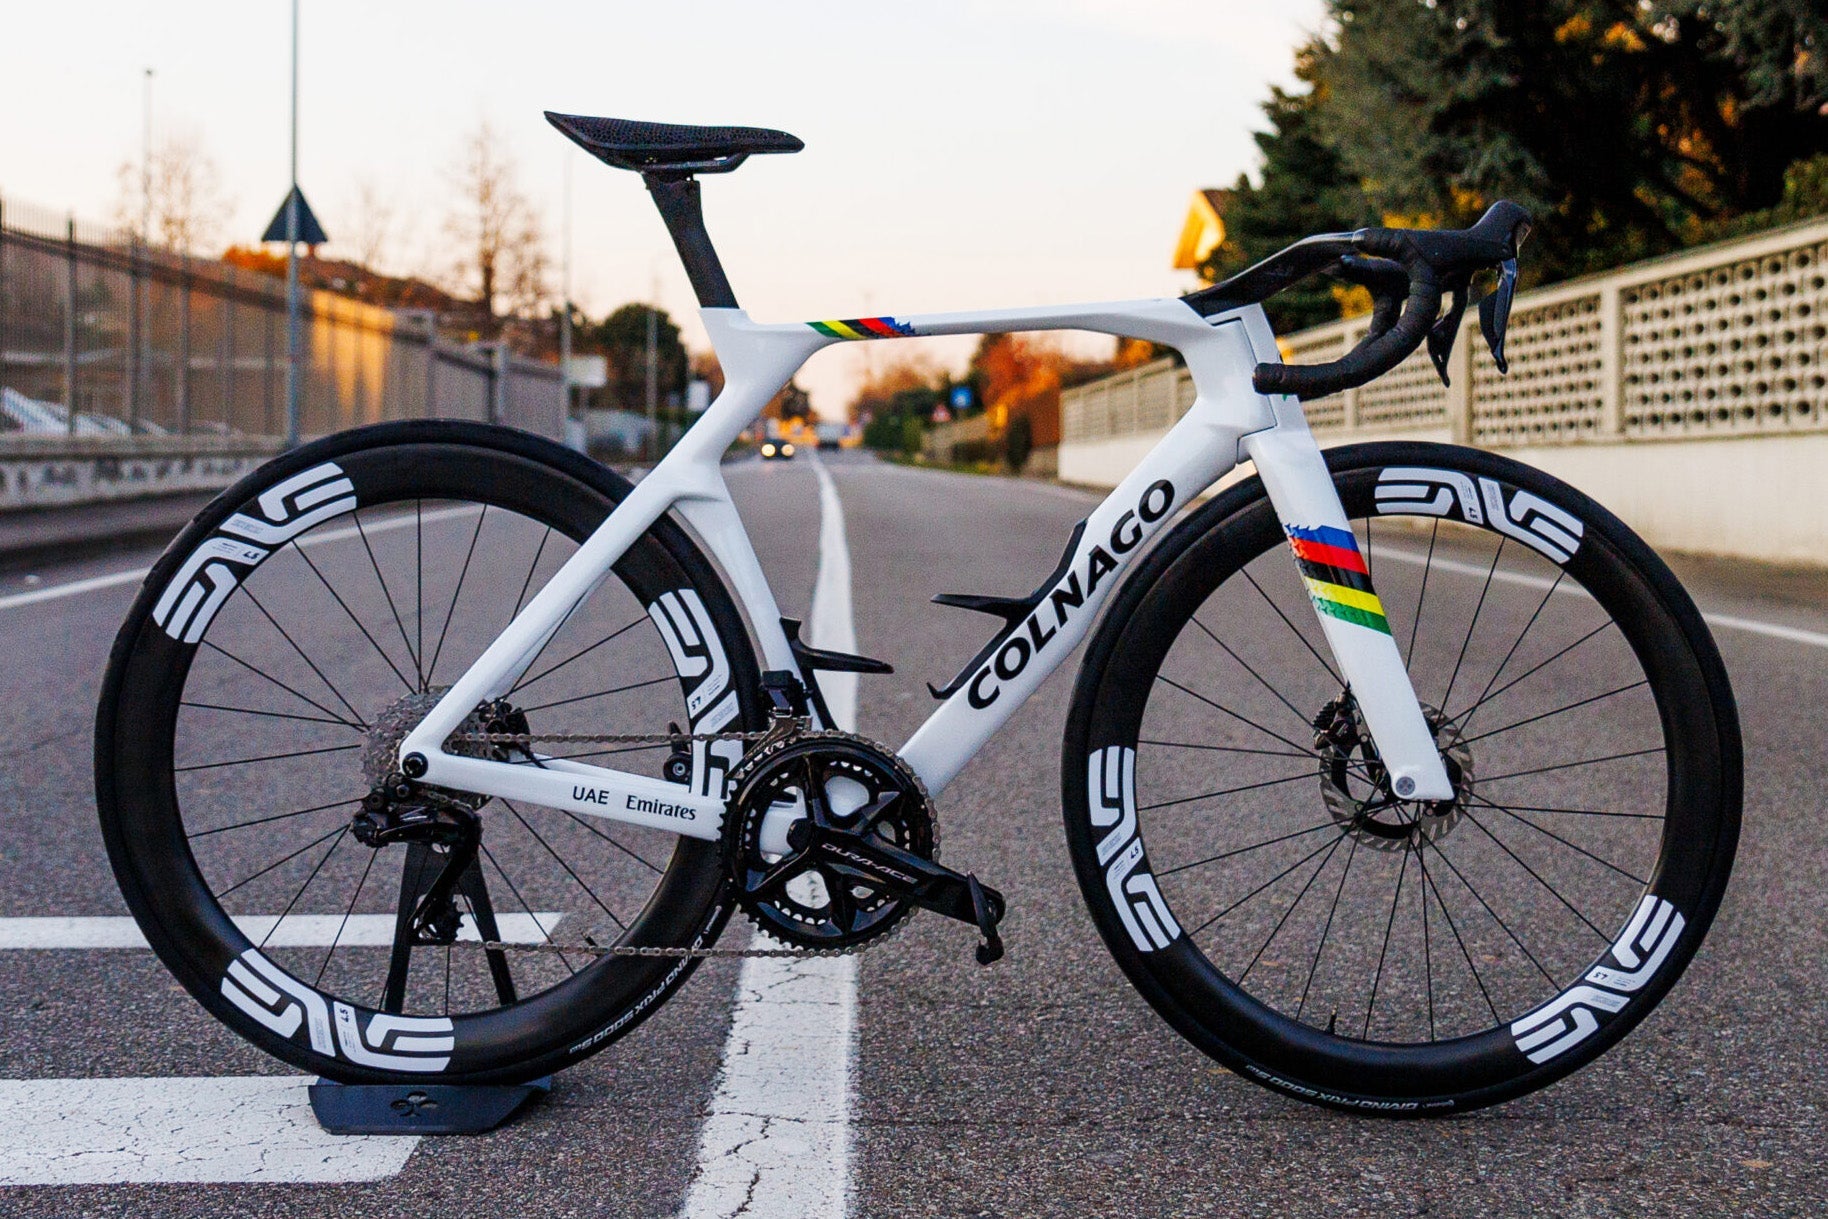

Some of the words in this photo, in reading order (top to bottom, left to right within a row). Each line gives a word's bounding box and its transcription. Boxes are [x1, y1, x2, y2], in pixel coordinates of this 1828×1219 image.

[967, 479, 1175, 710] COLNAGO
[573, 786, 609, 805] UAE
[626, 795, 697, 821] Emirates
[822, 842, 918, 884] DURA-ACE
[665, 935, 704, 986] GAND
[635, 981, 666, 1015] PRIX
[593, 1010, 634, 1044] 5000
[1318, 1092, 1360, 1107] PRIX
